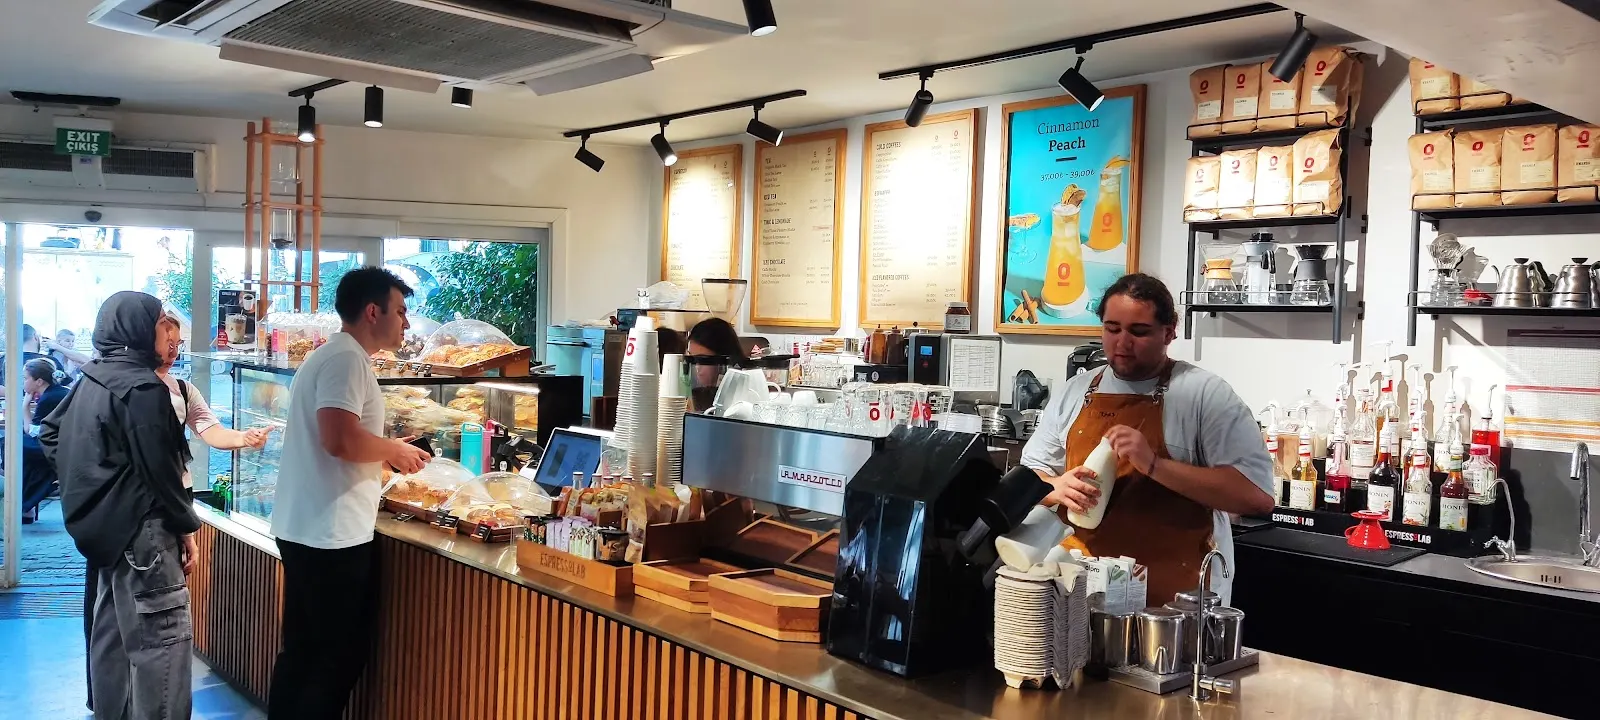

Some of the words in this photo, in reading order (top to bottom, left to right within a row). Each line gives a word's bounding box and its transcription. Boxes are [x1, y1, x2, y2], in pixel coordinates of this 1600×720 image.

[1037, 118, 1100, 135] Cinnamon
[67, 131, 100, 142] EXIT
[1048, 136, 1086, 152] Peach
[66, 141, 99, 155] ÇIKIŞ
